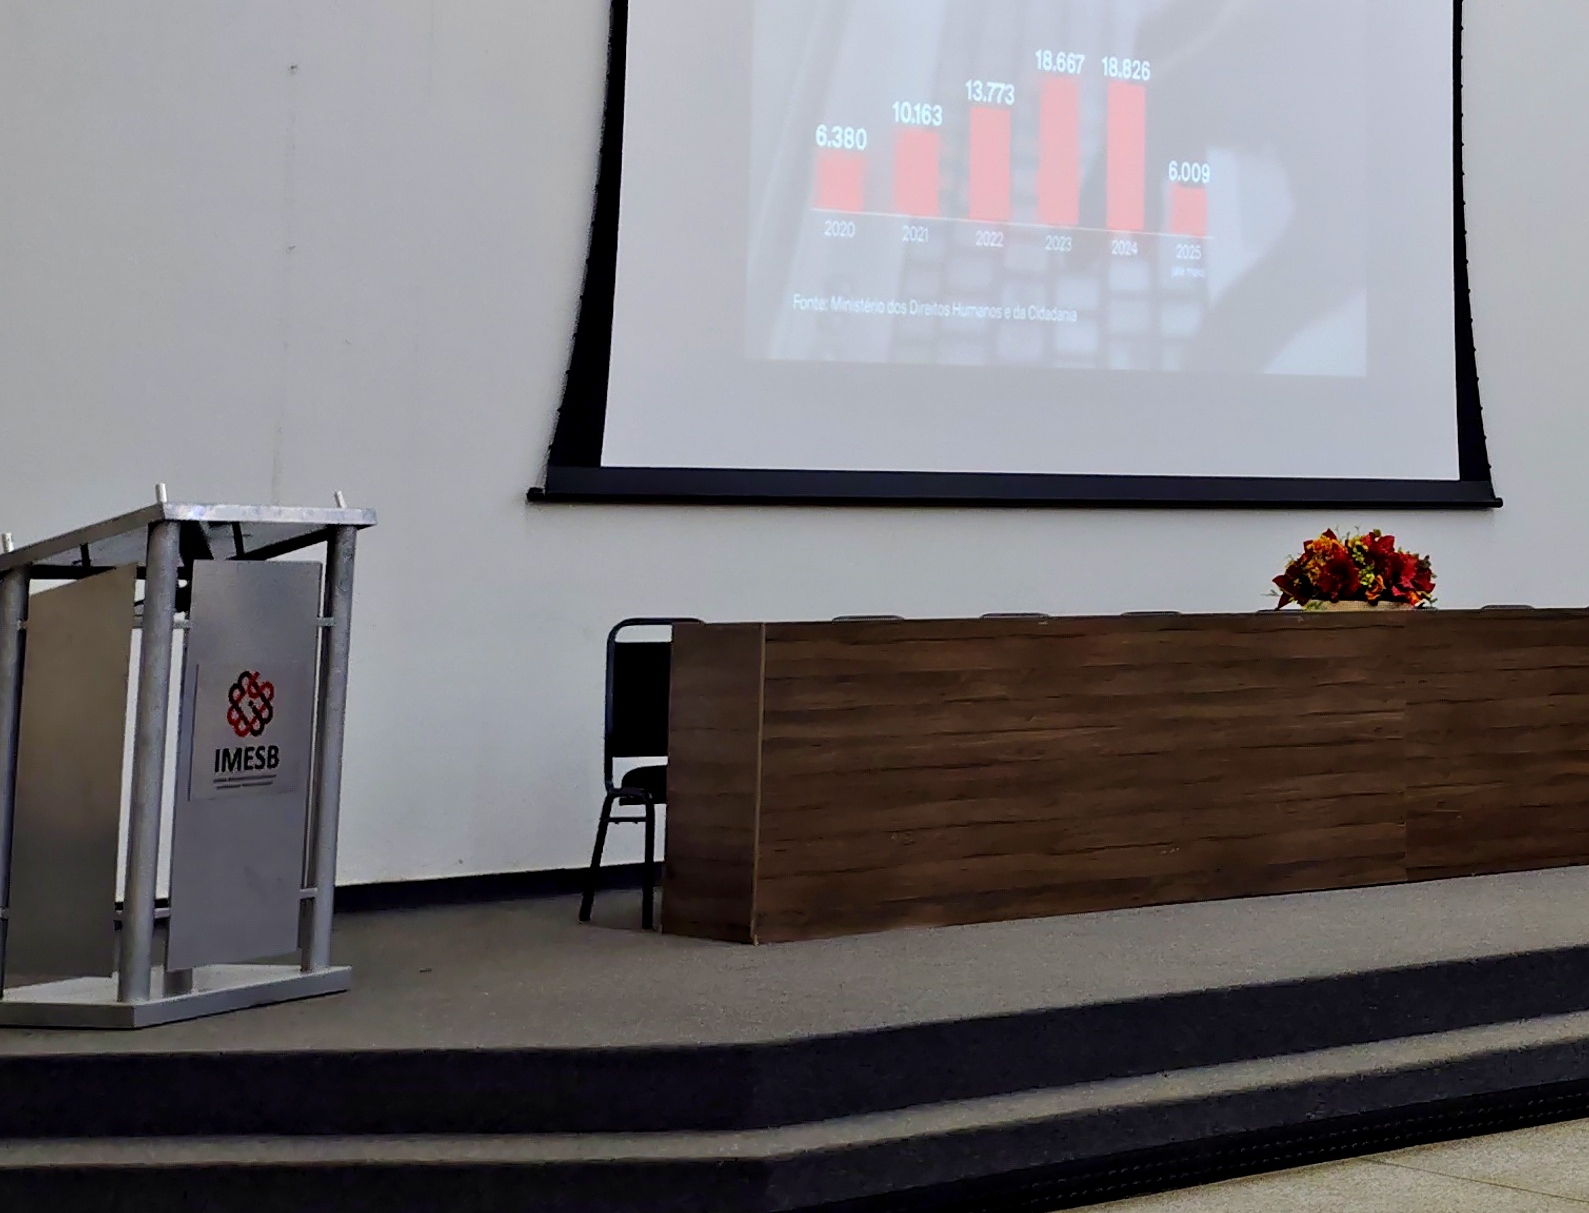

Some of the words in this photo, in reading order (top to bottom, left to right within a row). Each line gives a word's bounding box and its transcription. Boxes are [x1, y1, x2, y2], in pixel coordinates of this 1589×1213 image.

[1035, 49, 1085, 74] 18.667
[1101, 56, 1151, 81] 18.826
[965, 79, 1015, 105] 13.773
[892, 100, 943, 126] 10.163
[815, 124, 868, 149] 6.380
[1168, 160, 1210, 183] 6.009
[824, 220, 855, 238] 2020
[902, 225, 929, 243] 2021
[975, 230, 1004, 247] 2022
[1045, 235, 1072, 252] 2023
[1111, 239, 1138, 256] 2024
[1176, 244, 1202, 260] 2025
[793, 293, 828, 311] Fonte:
[830, 295, 884, 315] Ministério
[887, 299, 906, 316] dos
[909, 299, 950, 317] Direitos
[952, 302, 1002, 319] Humanos
[1013, 303, 1026, 321] da
[1028, 304, 1077, 322] Cidadania
[214, 745, 280, 773] IMESB
